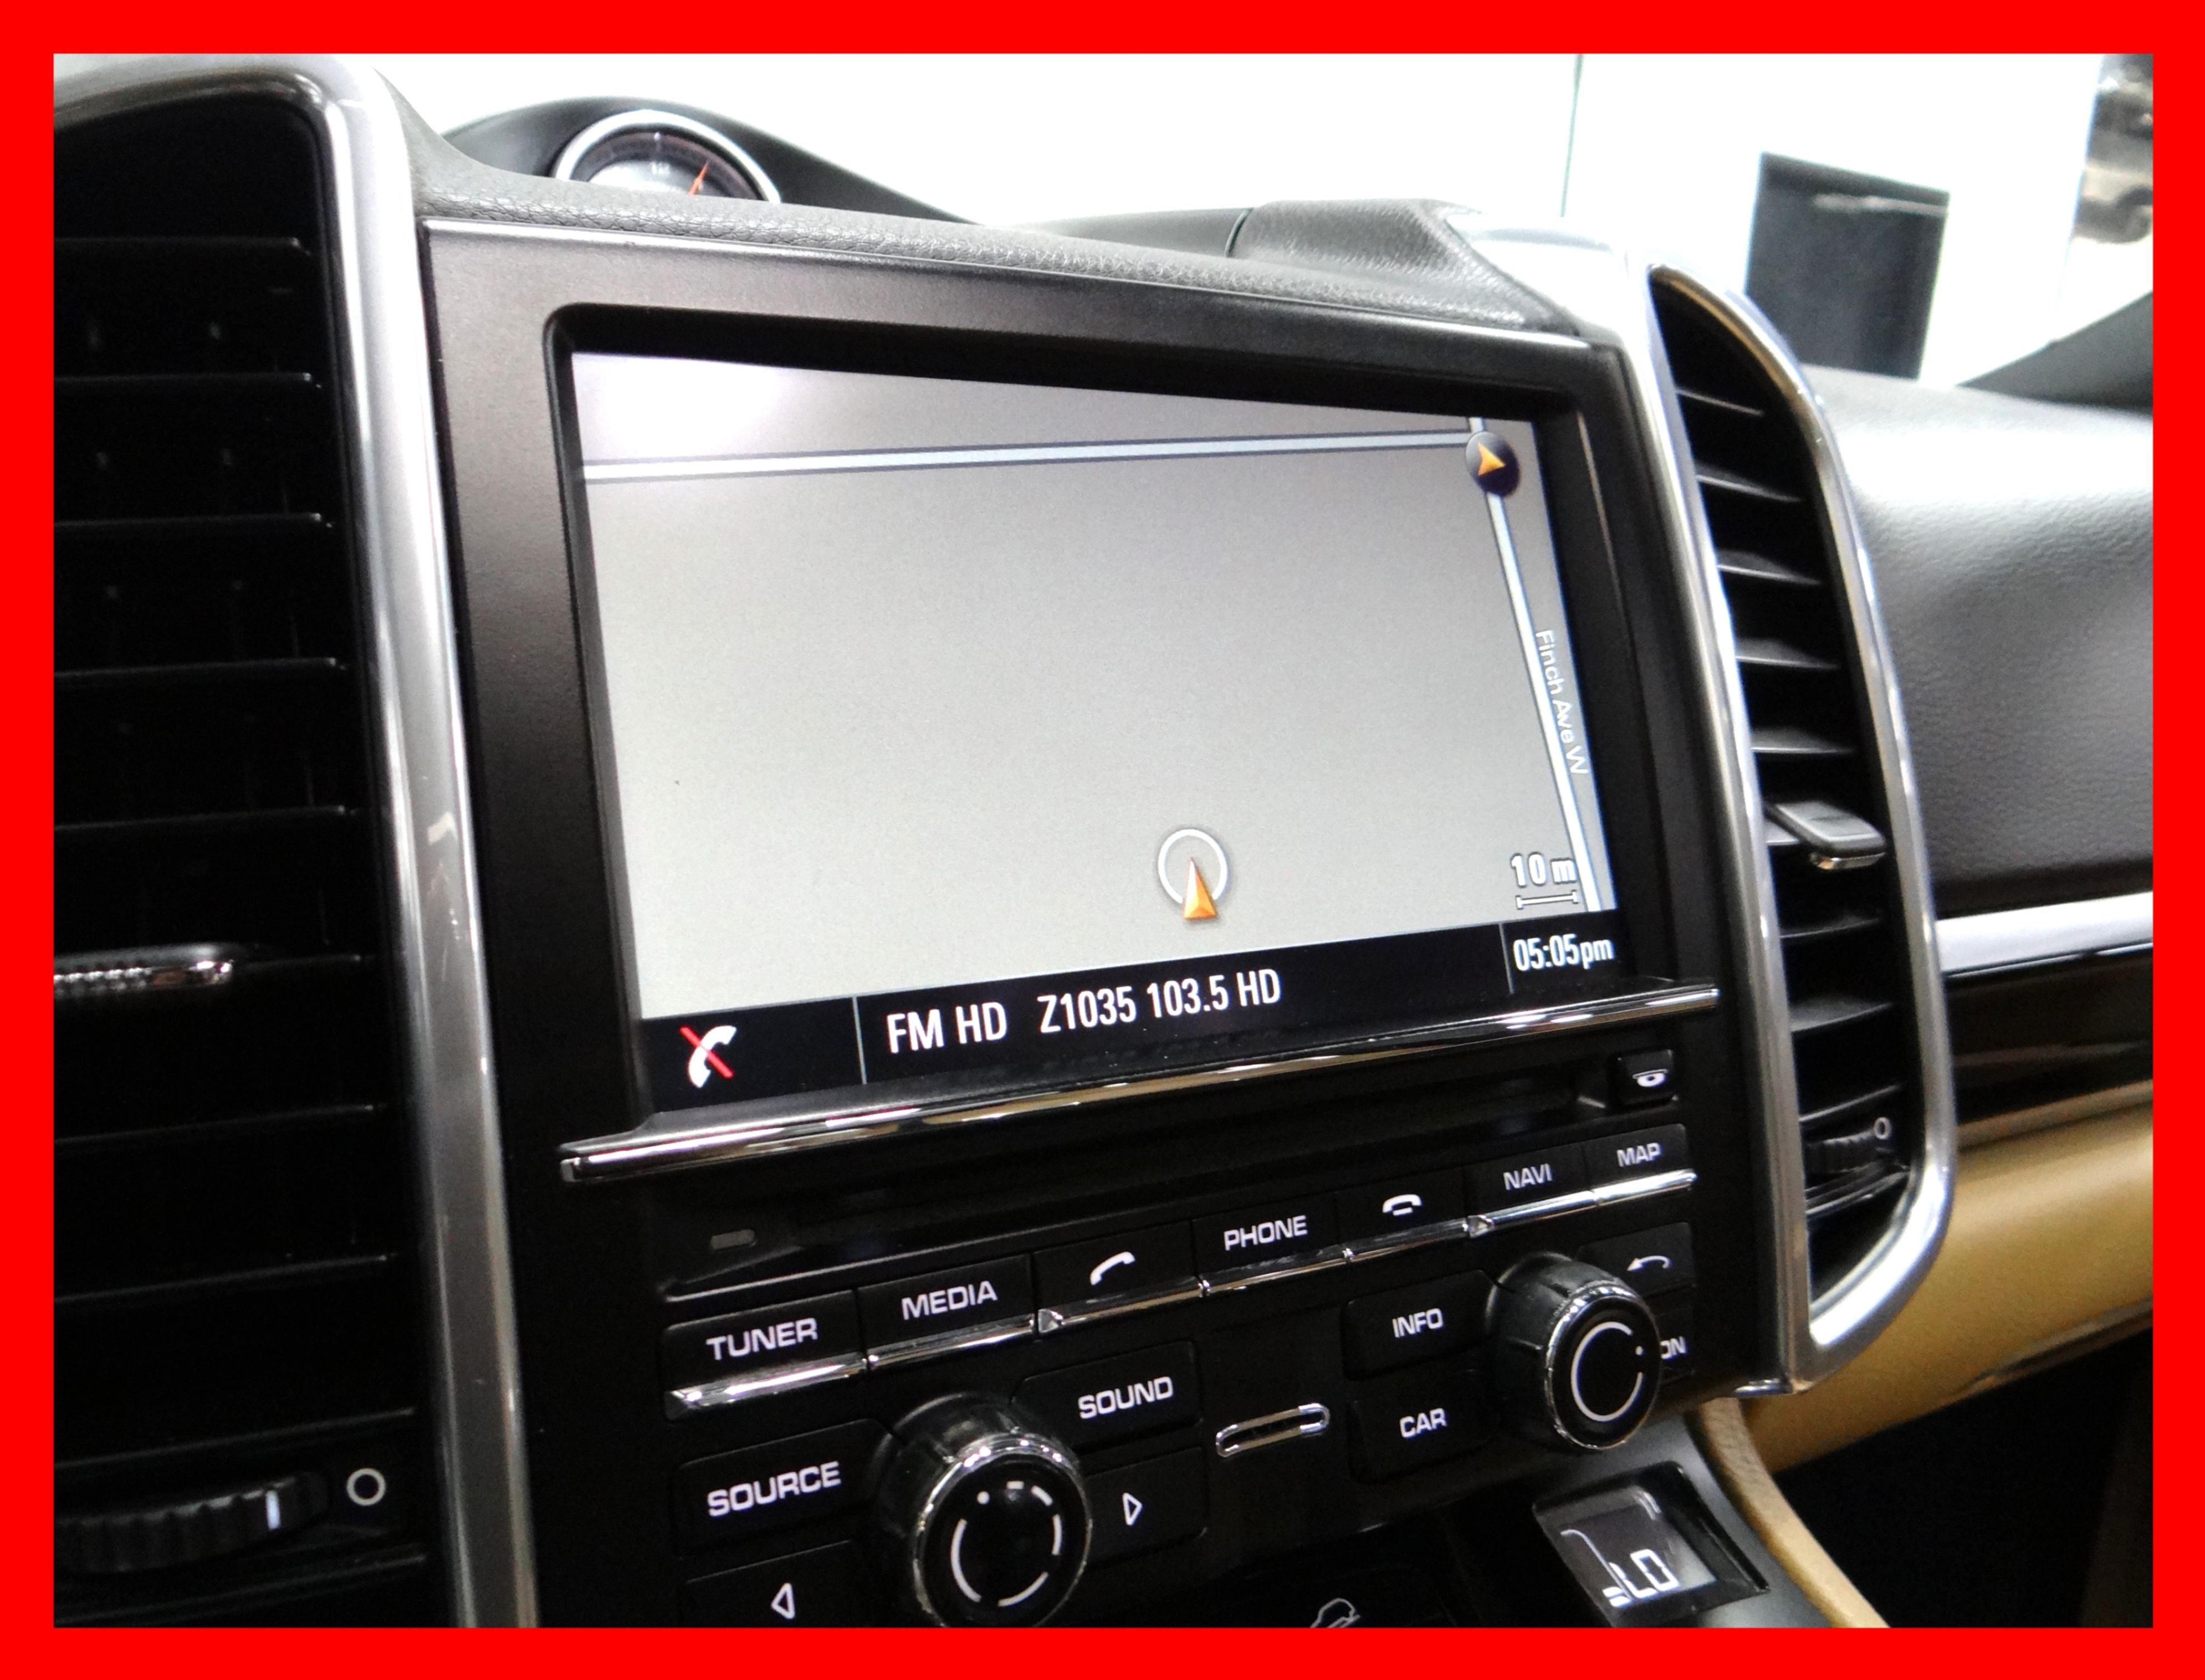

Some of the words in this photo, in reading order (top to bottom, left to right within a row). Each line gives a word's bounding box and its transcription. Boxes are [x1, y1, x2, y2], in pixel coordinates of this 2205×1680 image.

[1535, 629, 1565, 695] Finch
[1552, 699, 1577, 745] Ave
[1565, 746, 1589, 776] W
[1511, 852, 1547, 888] 10
[1551, 857, 1578, 884] m
[1512, 933, 1615, 972] 05:05pm
[887, 1012, 944, 1054] FM
[955, 1001, 1007, 1044] HD
[1037, 986, 1138, 1034] Z1035
[1147, 975, 1229, 1018] 103.5
[1237, 969, 1281, 1007] HD
[1616, 1142, 1661, 1167] MAP
[1503, 1164, 1553, 1191] NAVI
[1224, 1215, 1309, 1252] PHONE
[901, 1280, 998, 1320] MEDIA
[705, 1318, 818, 1361] TUNER
[1391, 1308, 1444, 1338] INFO
[1077, 1376, 1174, 1420] SOUND
[1399, 1407, 1447, 1439] CAR
[707, 1460, 842, 1517] SOURCE
